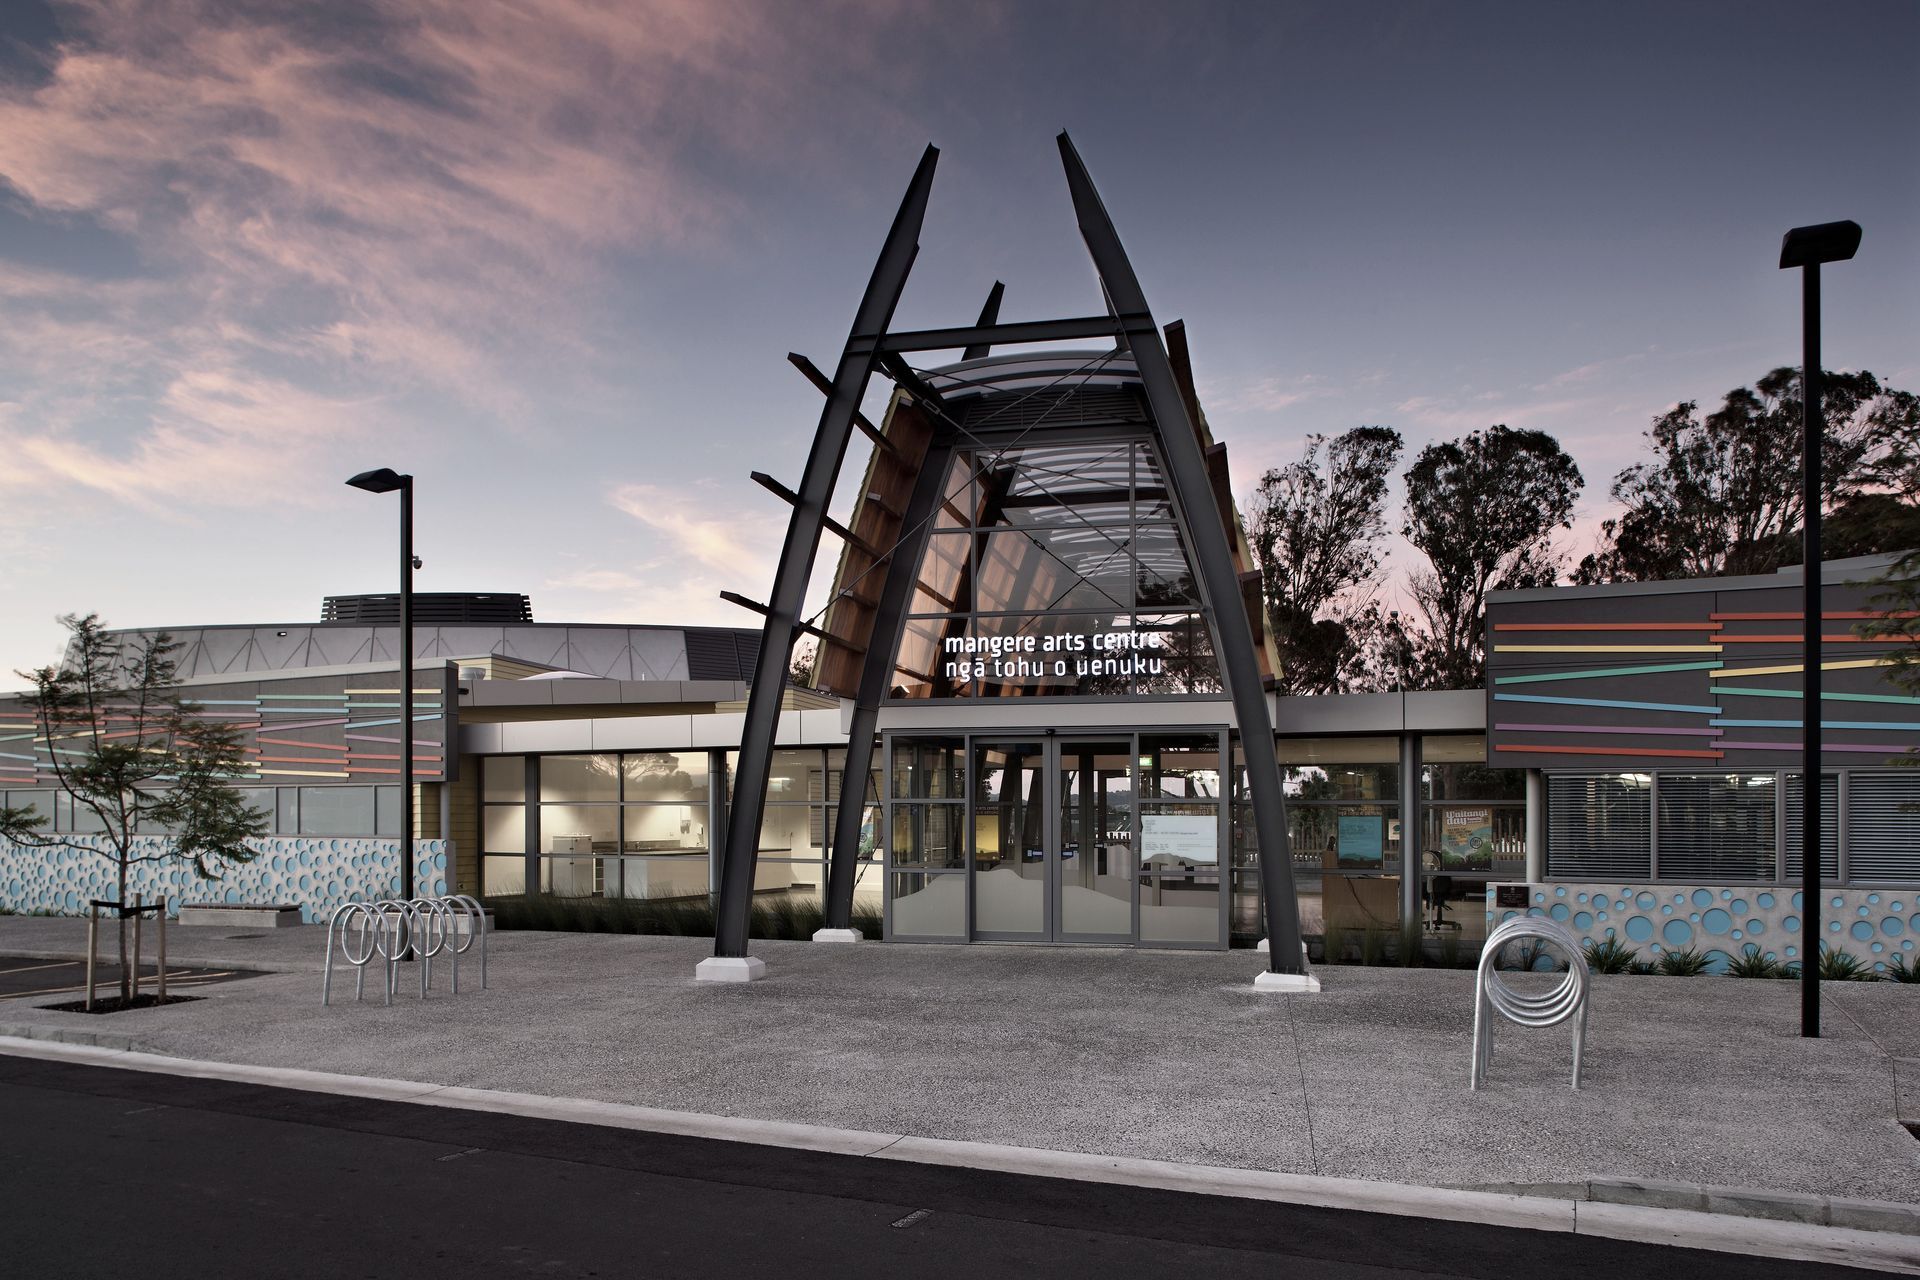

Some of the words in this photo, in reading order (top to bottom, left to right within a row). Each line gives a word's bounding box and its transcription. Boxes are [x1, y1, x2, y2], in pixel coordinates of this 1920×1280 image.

[945, 635, 1036, 658] mangere
[1042, 632, 1085, 652] arts
[1093, 629, 1160, 650] centre
[945, 657, 985, 682] ngā
[994, 656, 1044, 678] tohu
[1054, 660, 1066, 677] o
[1076, 653, 1162, 677] uenuku
[1446, 809, 1488, 818] Waitangi
[1446, 817, 1467, 825] day
